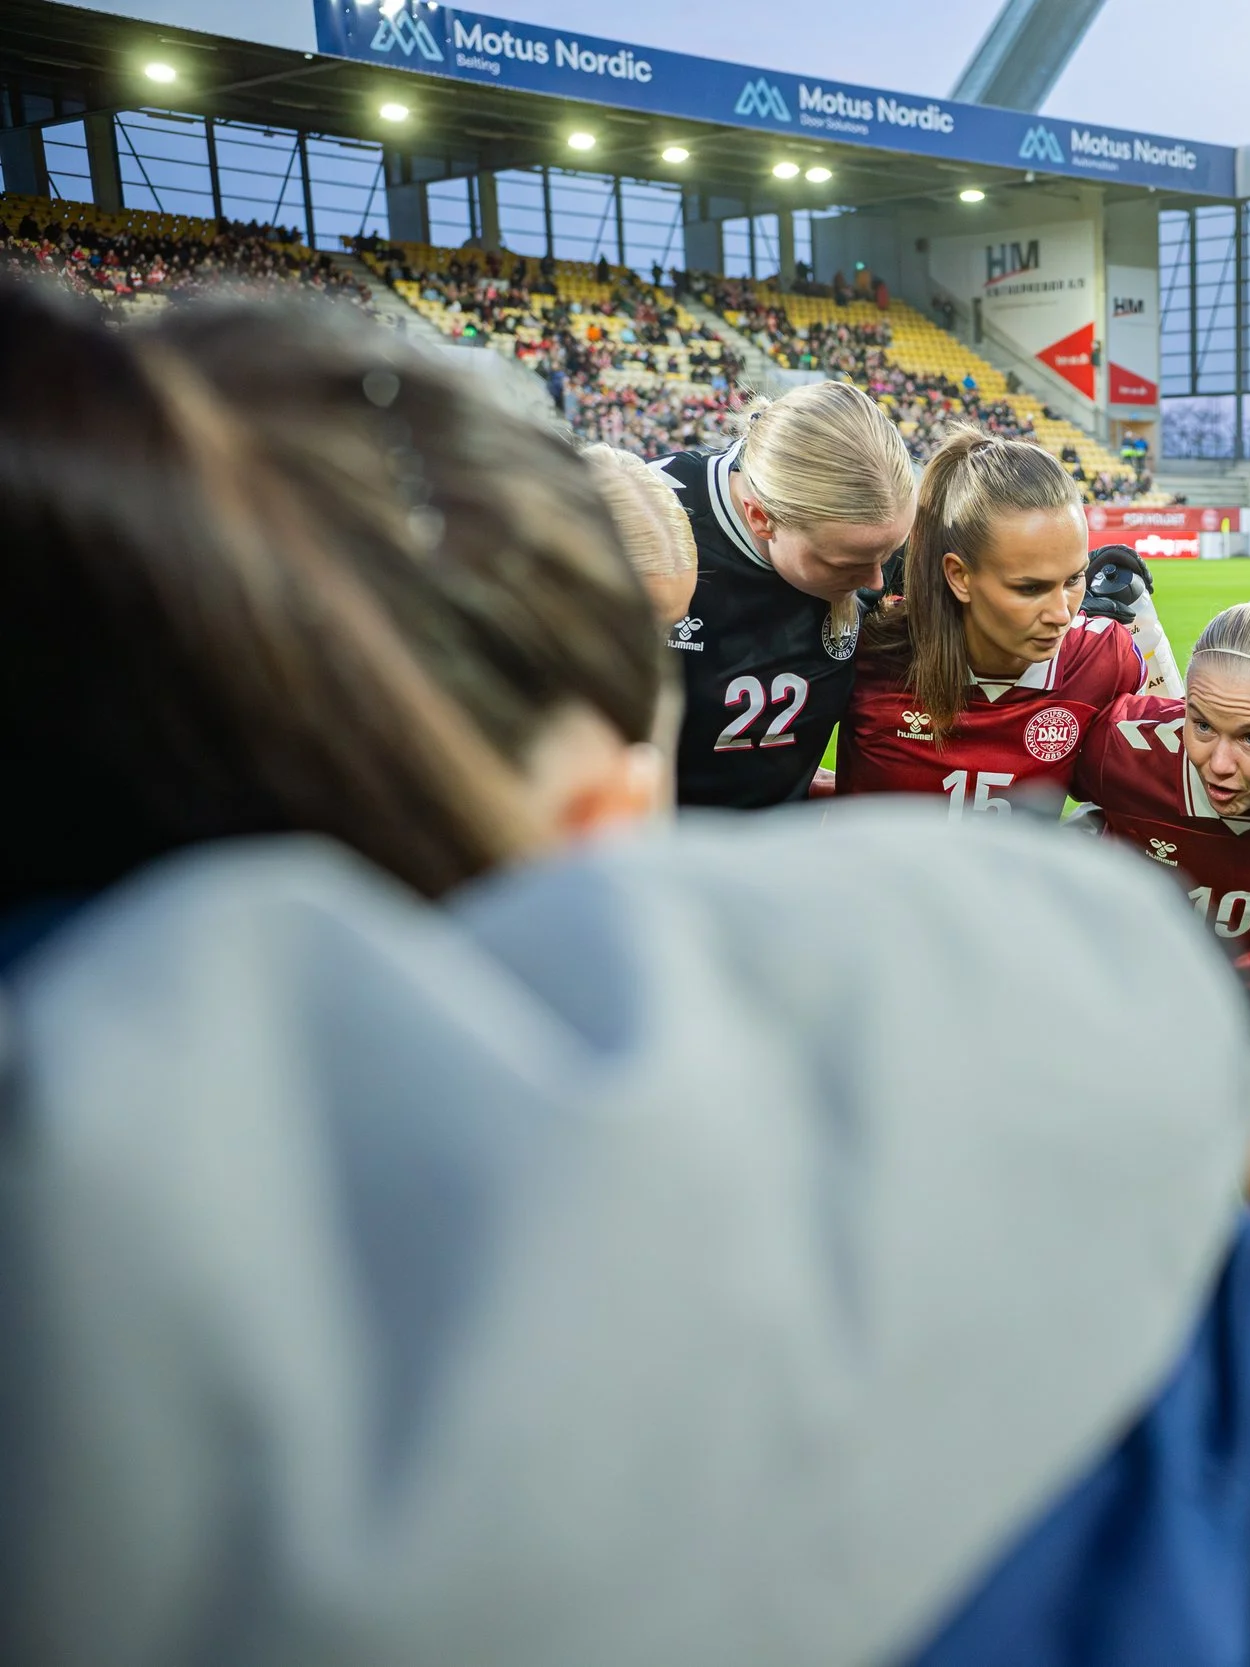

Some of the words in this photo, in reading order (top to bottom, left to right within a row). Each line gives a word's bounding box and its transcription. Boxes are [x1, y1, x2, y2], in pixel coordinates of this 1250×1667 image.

[454, 19, 549, 64] Motus
[554, 38, 653, 83] Nordic
[799, 83, 874, 121] Motus
[877, 97, 954, 133] Nordic
[1071, 128, 1131, 160] Motus
[1133, 139, 1197, 170] Nordic
[985, 240, 1040, 286] HM
[1113, 297, 1145, 314] HM
[713, 672, 810, 752] 22
[897, 729, 934, 741] hummel
[1037, 726, 1069, 743] DBU
[942, 770, 1015, 824] 15
